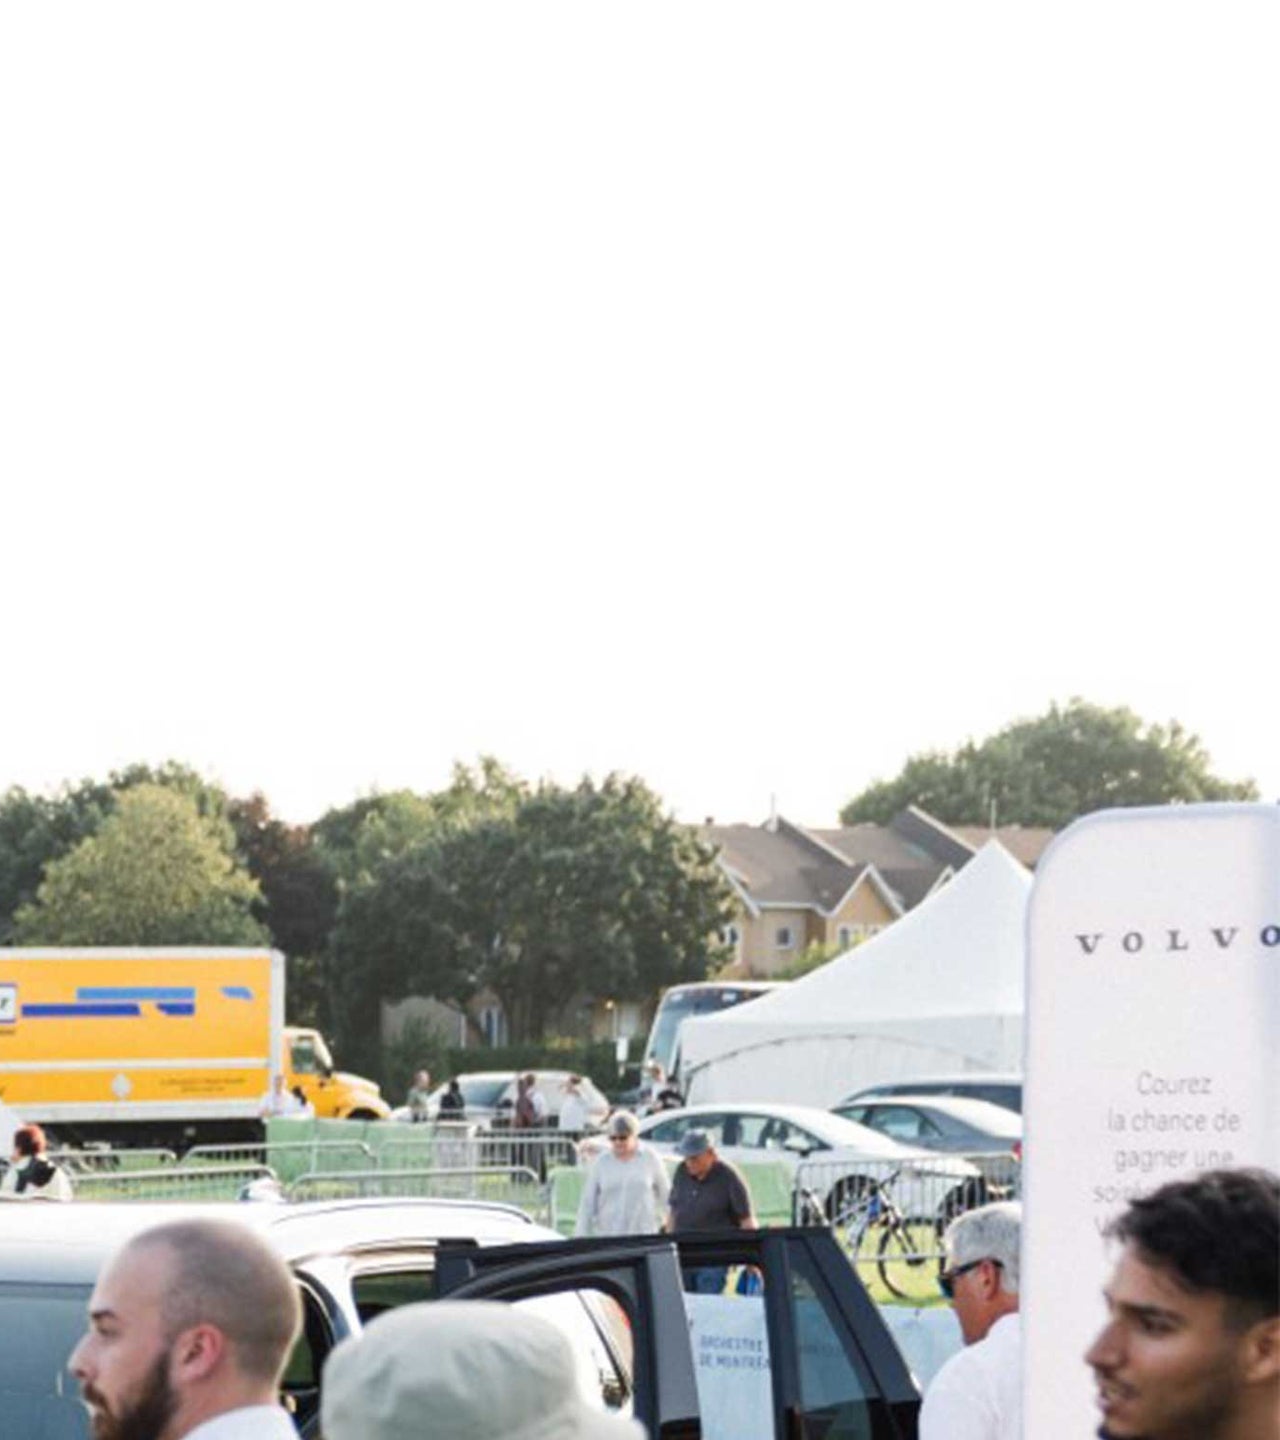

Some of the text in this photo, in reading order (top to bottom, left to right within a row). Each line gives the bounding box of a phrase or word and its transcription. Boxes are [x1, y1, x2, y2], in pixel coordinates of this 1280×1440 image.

[1075, 925, 1280, 955] VOLVO
[1137, 1070, 1212, 1095] Courez
[1108, 1107, 1240, 1132] la chance de
[1115, 1148, 1233, 1173] gagner une
